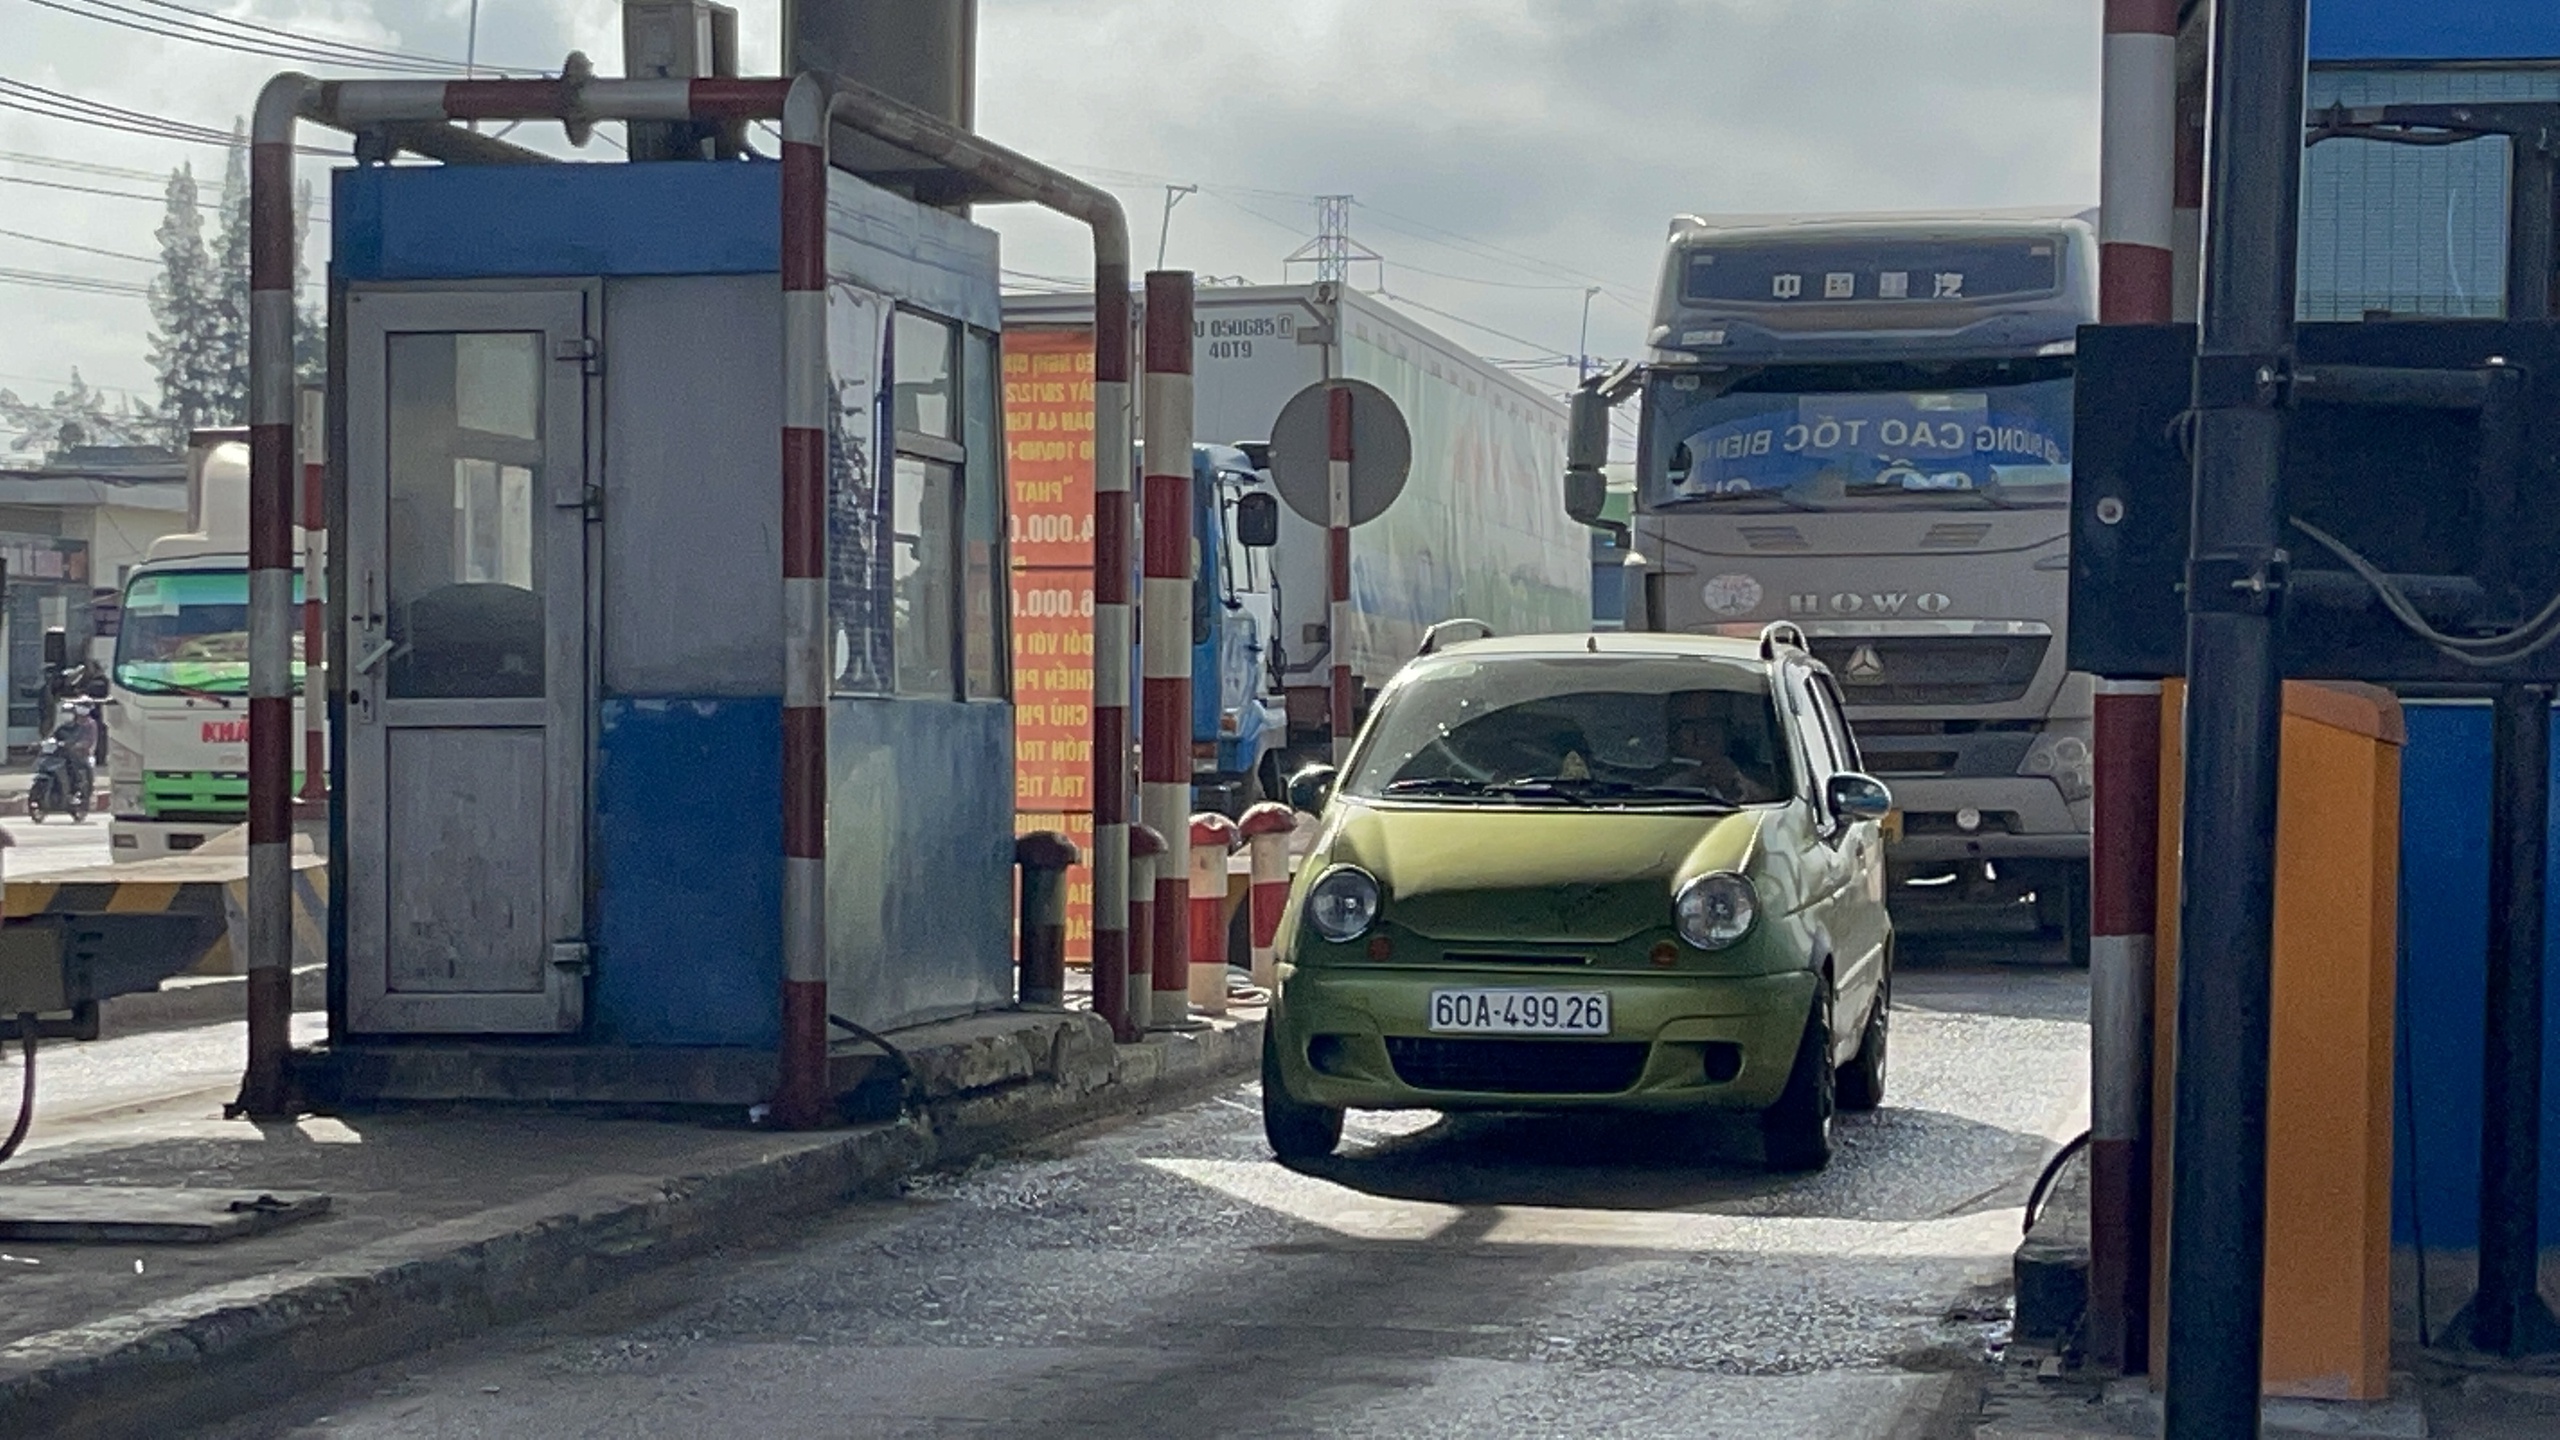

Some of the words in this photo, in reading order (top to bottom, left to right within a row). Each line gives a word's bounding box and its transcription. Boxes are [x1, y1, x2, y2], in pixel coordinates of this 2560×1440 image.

[1208, 340, 1253, 359] 40T9
[1789, 592, 1952, 615] HOWO
[1435, 994, 1603, 1029] 60A-499.26
